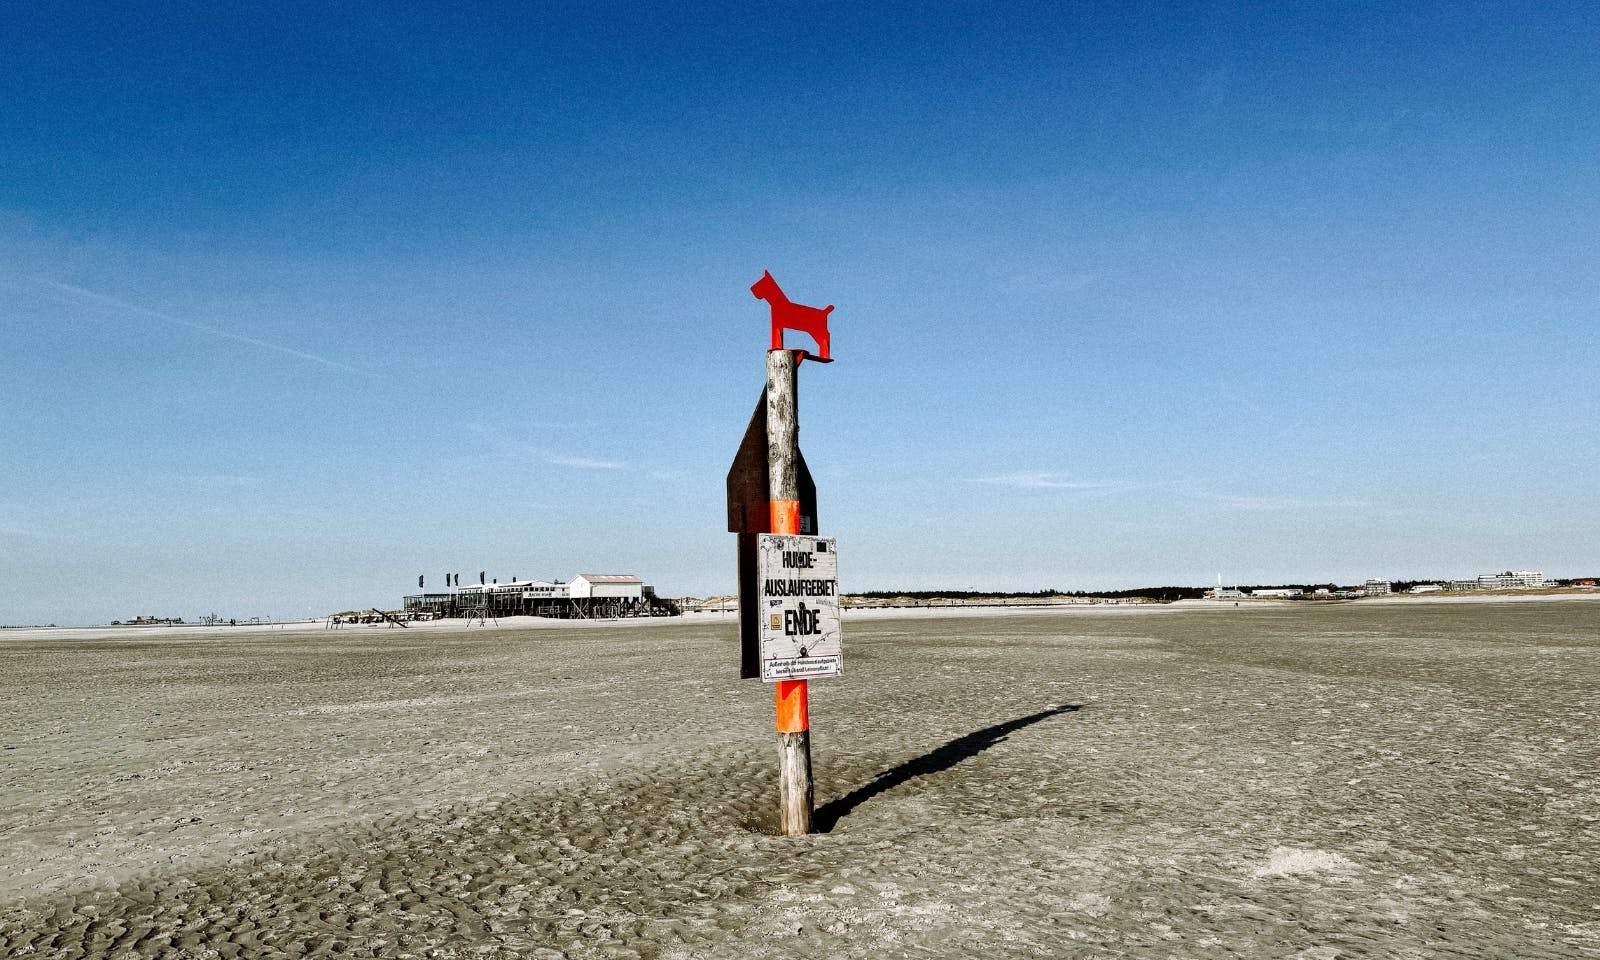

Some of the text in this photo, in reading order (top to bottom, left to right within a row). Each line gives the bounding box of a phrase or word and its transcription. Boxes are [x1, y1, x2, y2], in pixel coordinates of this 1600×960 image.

[782, 551, 817, 569] HUNDE-
[764, 579, 836, 597] AUSLAUFGEBIET
[784, 609, 822, 636] ENDE
